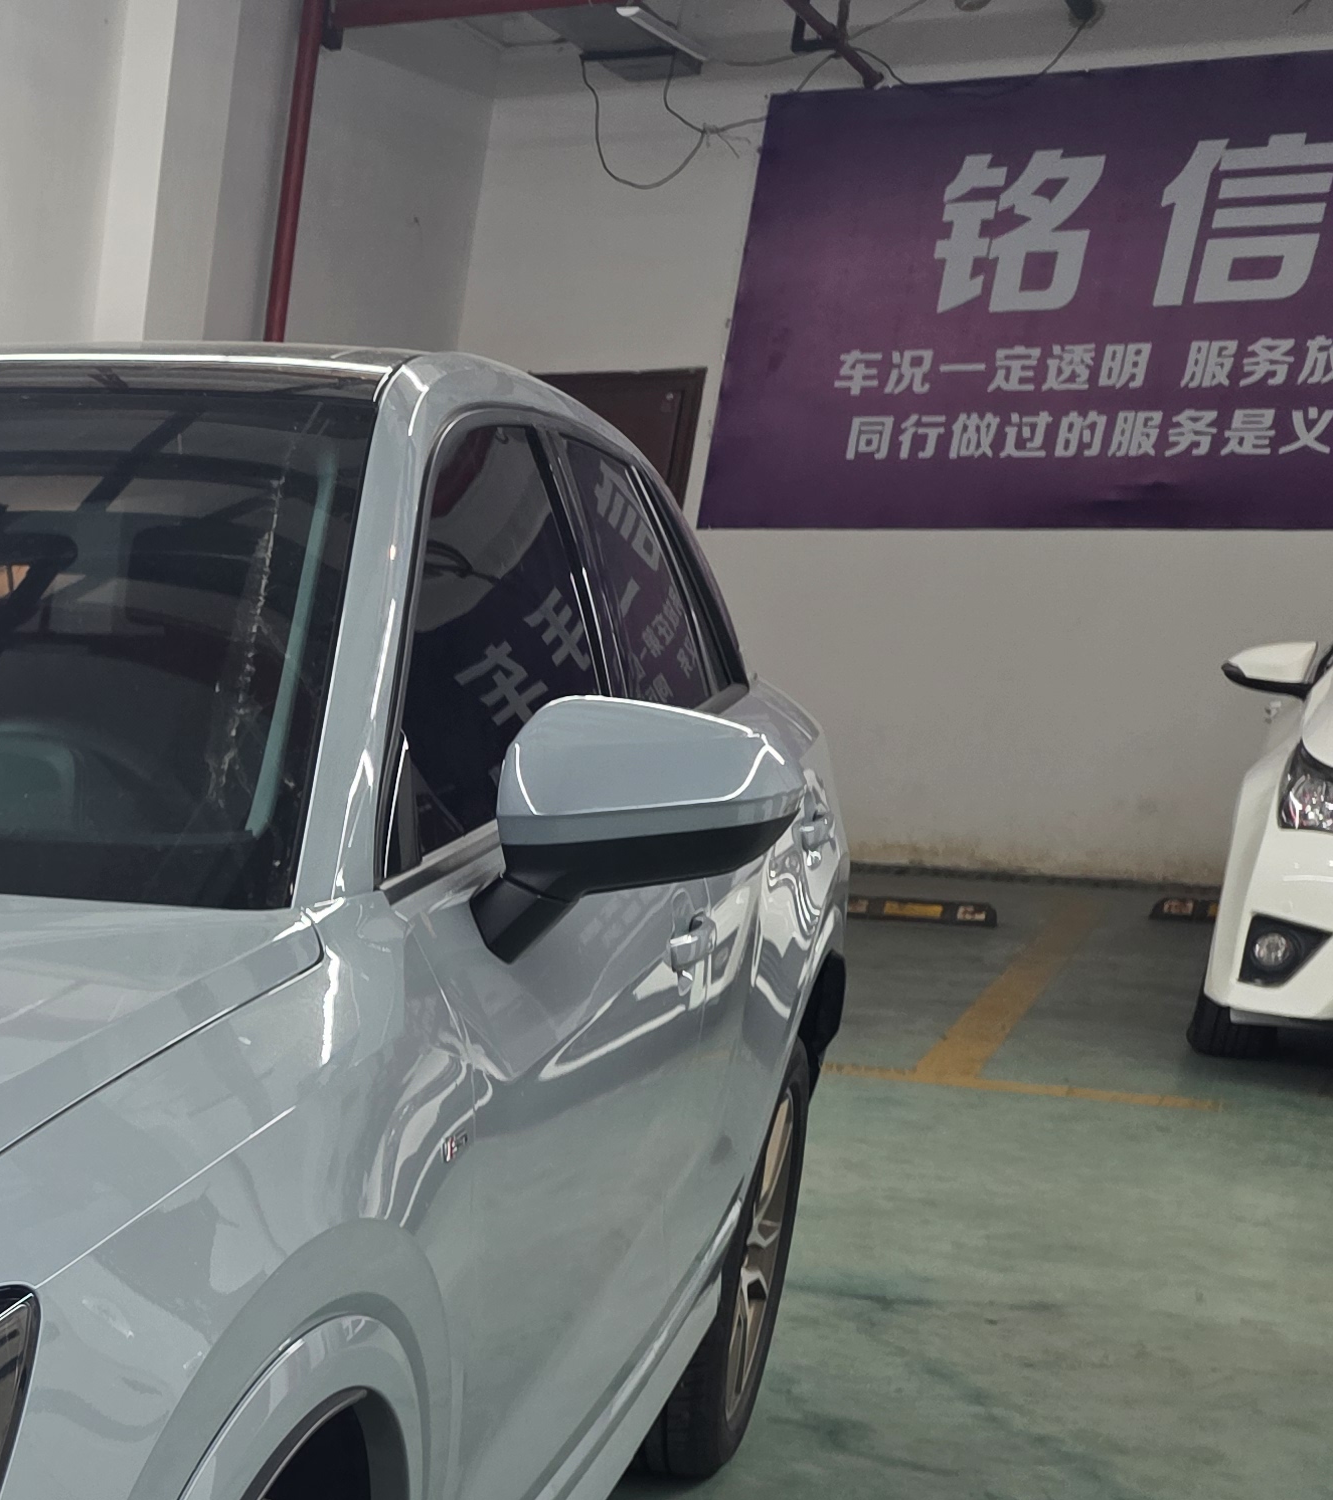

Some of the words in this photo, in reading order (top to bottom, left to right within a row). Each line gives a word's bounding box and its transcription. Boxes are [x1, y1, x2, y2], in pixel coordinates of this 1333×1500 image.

[934, 132, 1333, 313] 铭信
[834, 342, 1151, 395] 车况一定透明
[846, 405, 1333, 460] 同行做过的服务是义
